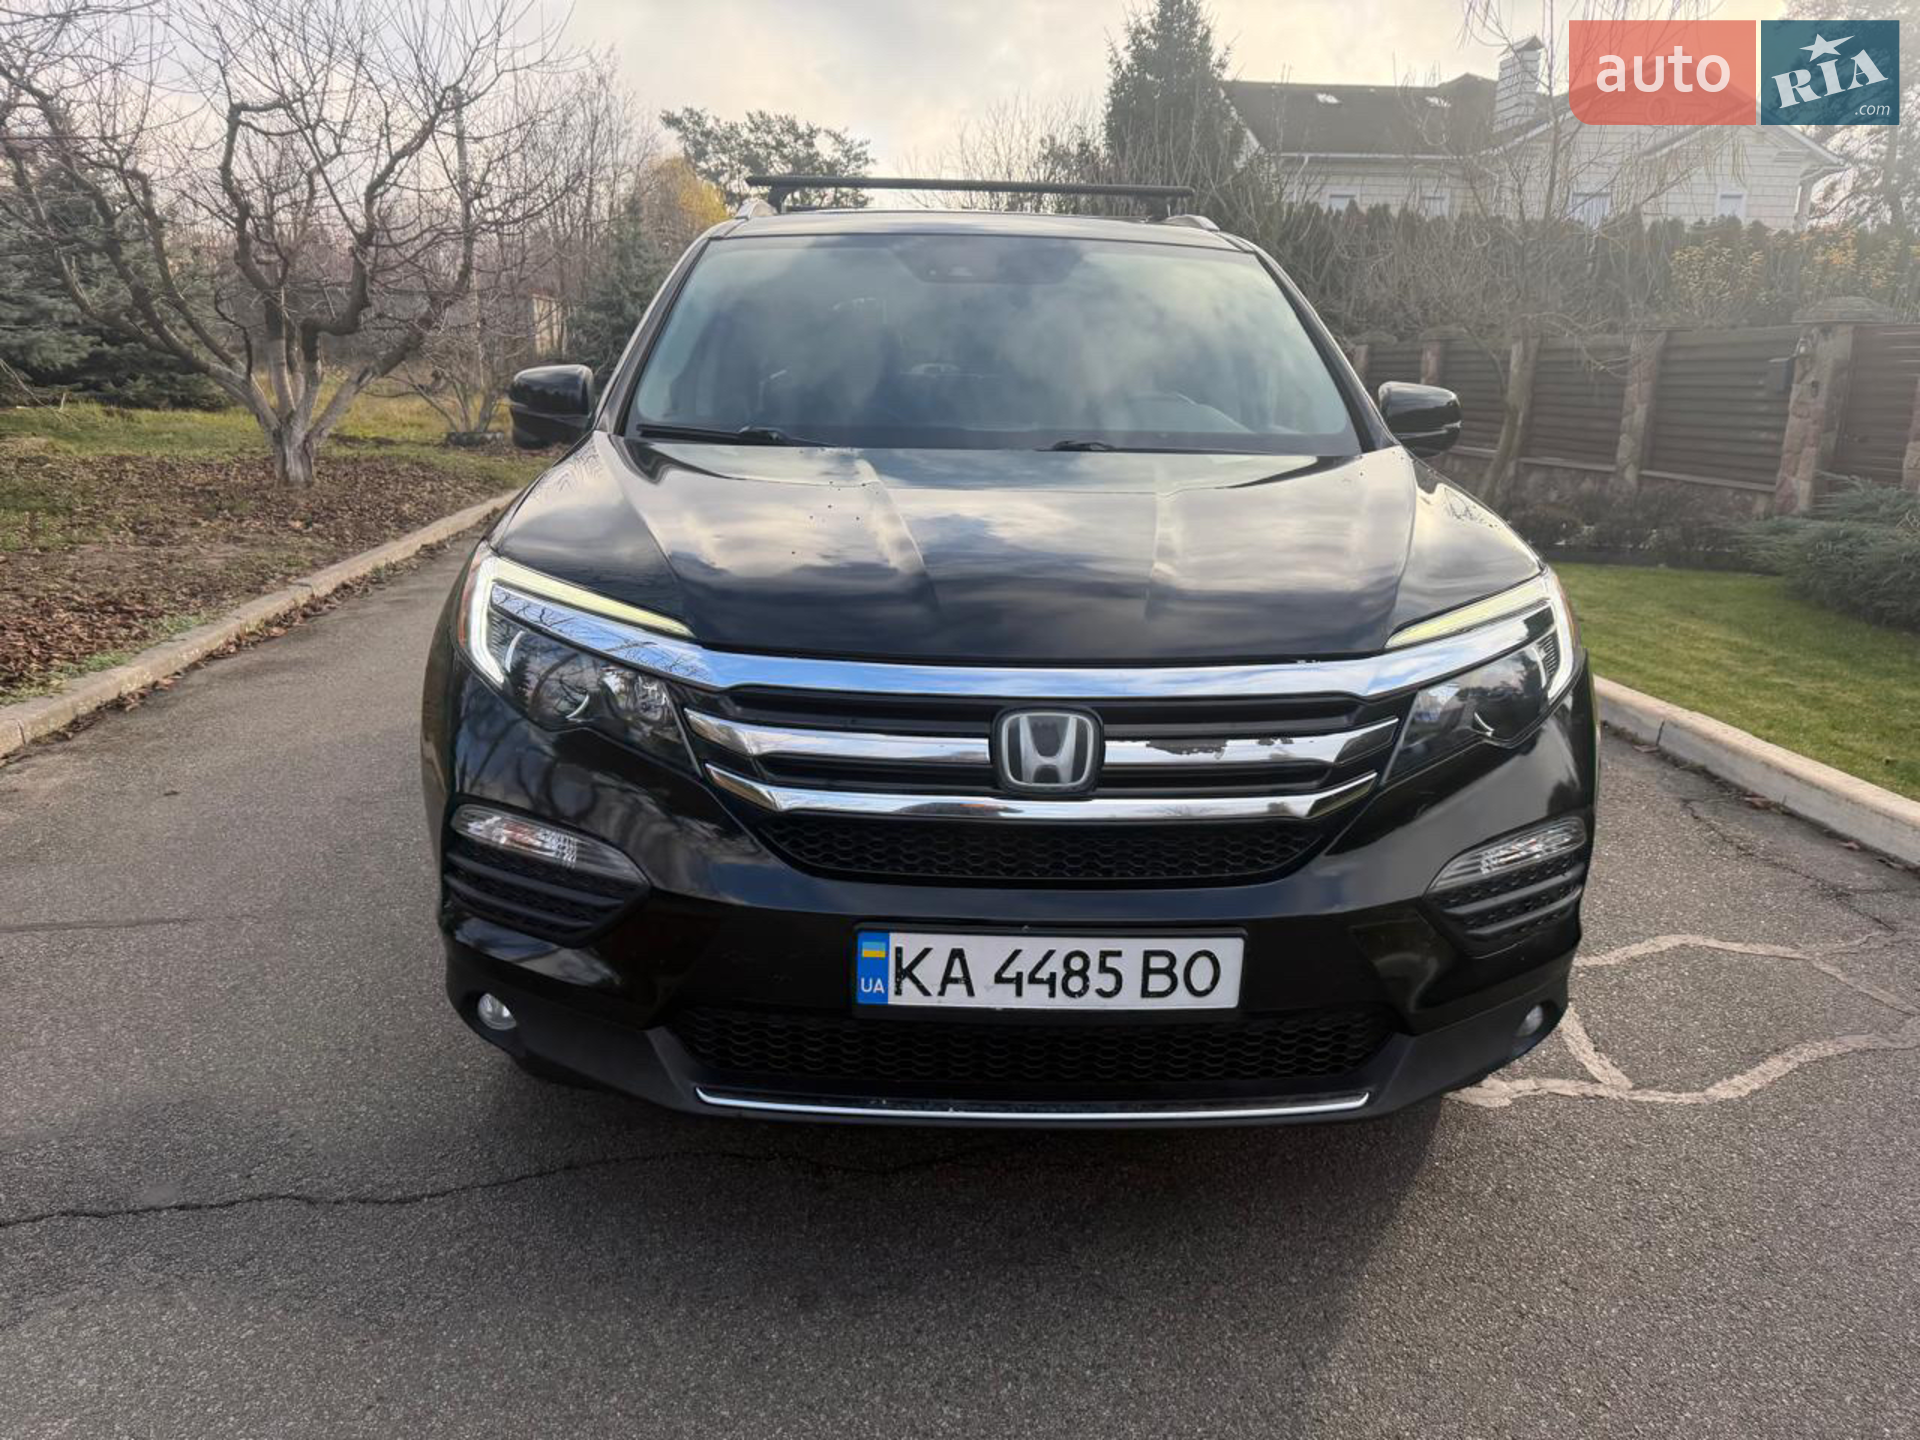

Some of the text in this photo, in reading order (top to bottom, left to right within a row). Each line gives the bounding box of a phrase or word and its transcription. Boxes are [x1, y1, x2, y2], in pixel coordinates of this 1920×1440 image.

[860, 977, 885, 994] UA
[893, 946, 1221, 1000] KA 4485 BO
